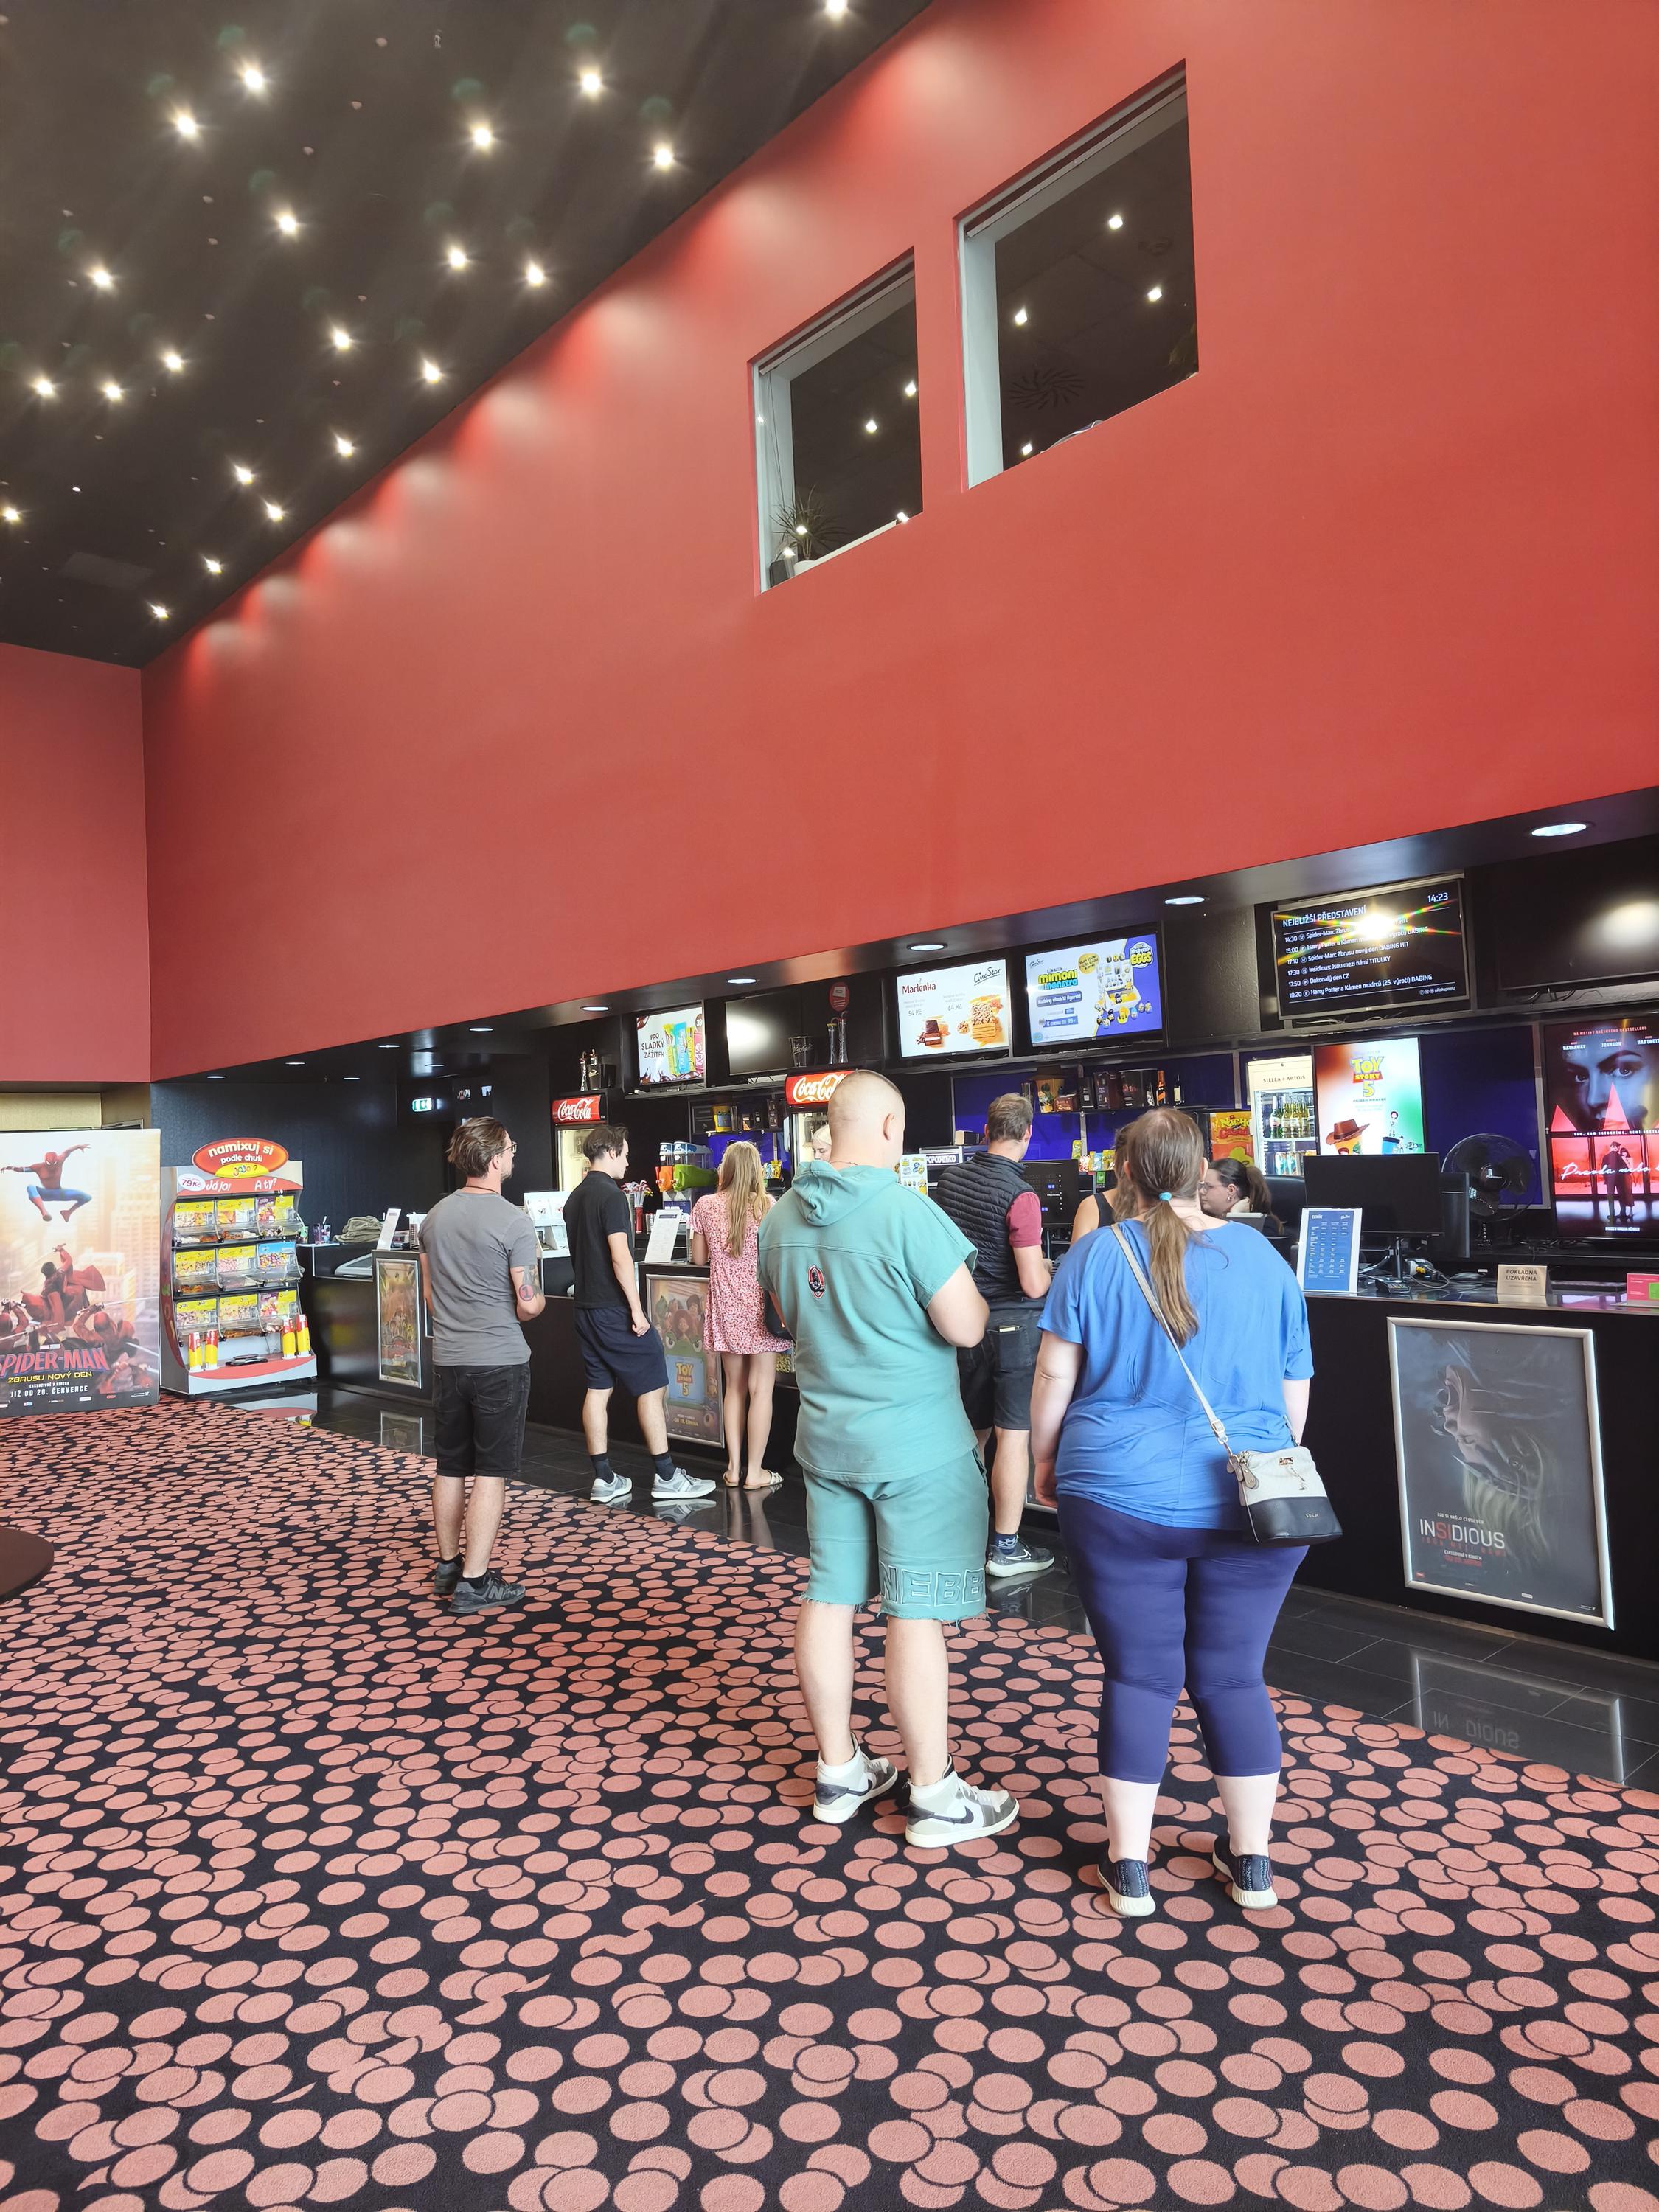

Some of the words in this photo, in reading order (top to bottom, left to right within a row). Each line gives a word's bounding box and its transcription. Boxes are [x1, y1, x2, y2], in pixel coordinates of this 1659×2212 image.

[1427, 893, 1448, 902] 14:23
[1283, 914, 1315, 927] NEJBLIŽŠÍ
[1318, 905, 1366, 921] PŘEDSTAVENÍ
[1355, 948, 1367, 956] nový
[1380, 942, 1399, 951] DABING
[1130, 952, 1152, 965] EGGS
[1369, 956, 1391, 964] TITULKY
[1310, 975, 1332, 984] Dokonalý
[1325, 985, 1340, 993] Potter
[1345, 983, 1362, 991] Kámen
[1363, 980, 1381, 989] mudrců
[1394, 977, 1410, 985] výročí)
[1412, 974, 1432, 982] DABING
[902, 982, 936, 994] Marlenka
[641, 1038, 664, 1050] SLADKÝ
[1351, 1056, 1385, 1074] TOY
[1363, 1080, 1374, 1097] 5
[208, 1141, 260, 1157] namixuj
[263, 1146, 274, 1155] si
[220, 1154, 243, 1165] podle
[245, 1154, 262, 1162] chuti
[254, 1180, 261, 1191] A
[263, 1178, 277, 1189] ty?
[675, 1362, 693, 1375] TOY
[7, 1375, 45, 1383] ZBRUSU
[48, 1371, 72, 1381] NOVÝ
[74, 1371, 92, 1379] DEN
[10, 1389, 21, 1398] JIŽ
[52, 1385, 88, 1394] ČERVENCE
[682, 1382, 689, 1397] 5
[1420, 1519, 1505, 1549] INSIDIOUS
